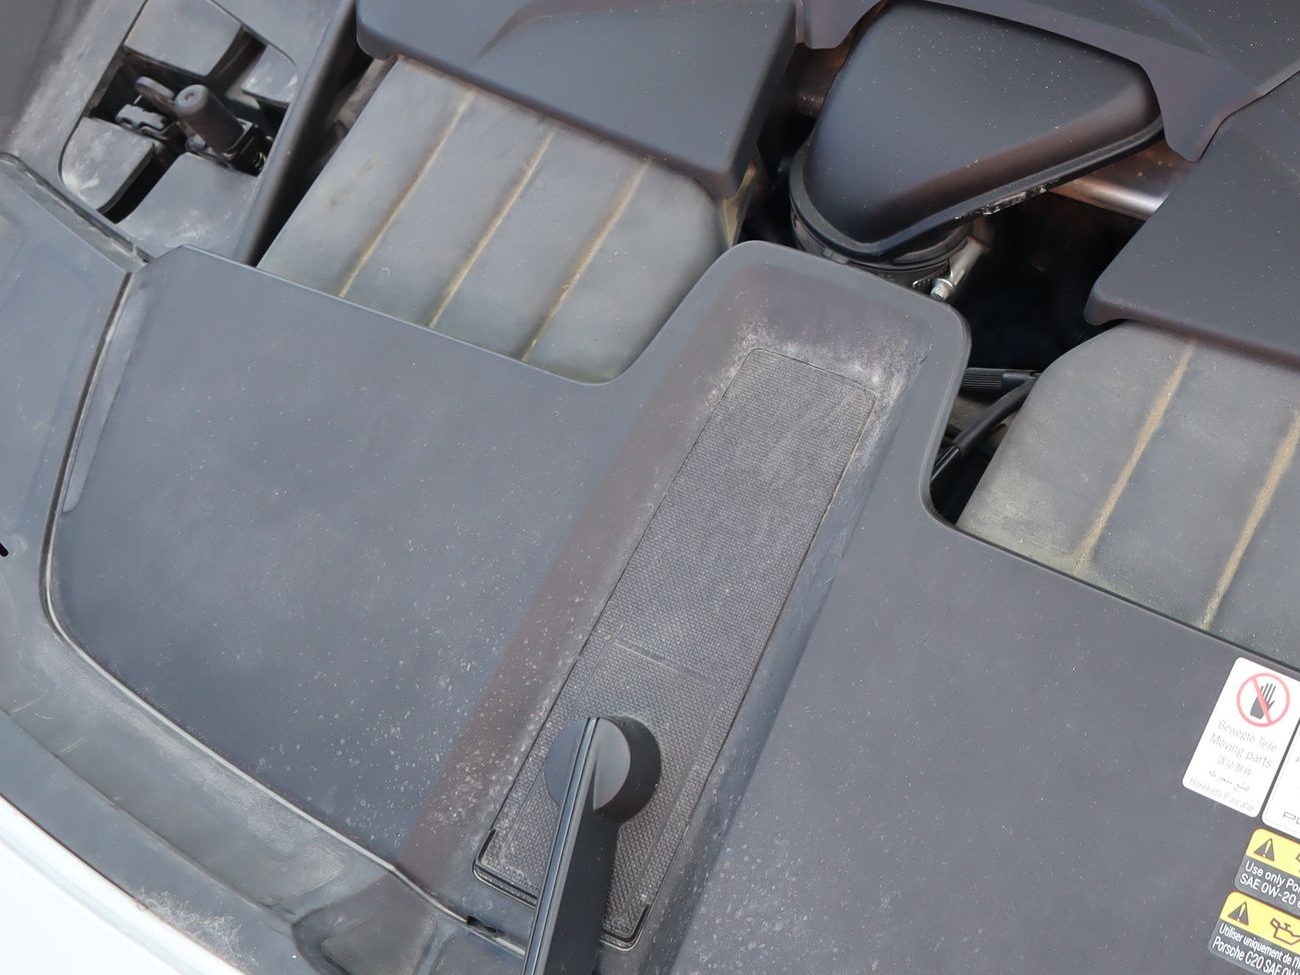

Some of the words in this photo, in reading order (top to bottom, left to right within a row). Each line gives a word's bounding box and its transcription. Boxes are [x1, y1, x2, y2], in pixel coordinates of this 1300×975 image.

[1209, 732, 1245, 759] Moving
[1244, 751, 1273, 769] parts
[1217, 719, 1256, 744] Bewegte
[1258, 736, 1278, 753] Teile
[1239, 874, 1261, 891] SAE
[1261, 882, 1298, 906] 0W-20
[1245, 860, 1263, 877] Use
[1266, 871, 1285, 887] only
[1212, 935, 1245, 961] Porsche
[1244, 948, 1264, 970] C20
[1263, 961, 1281, 975] SAE
[1219, 922, 1245, 943] Utiliser
[1243, 934, 1284, 961] uniquement
[1282, 948, 1294, 965] de
